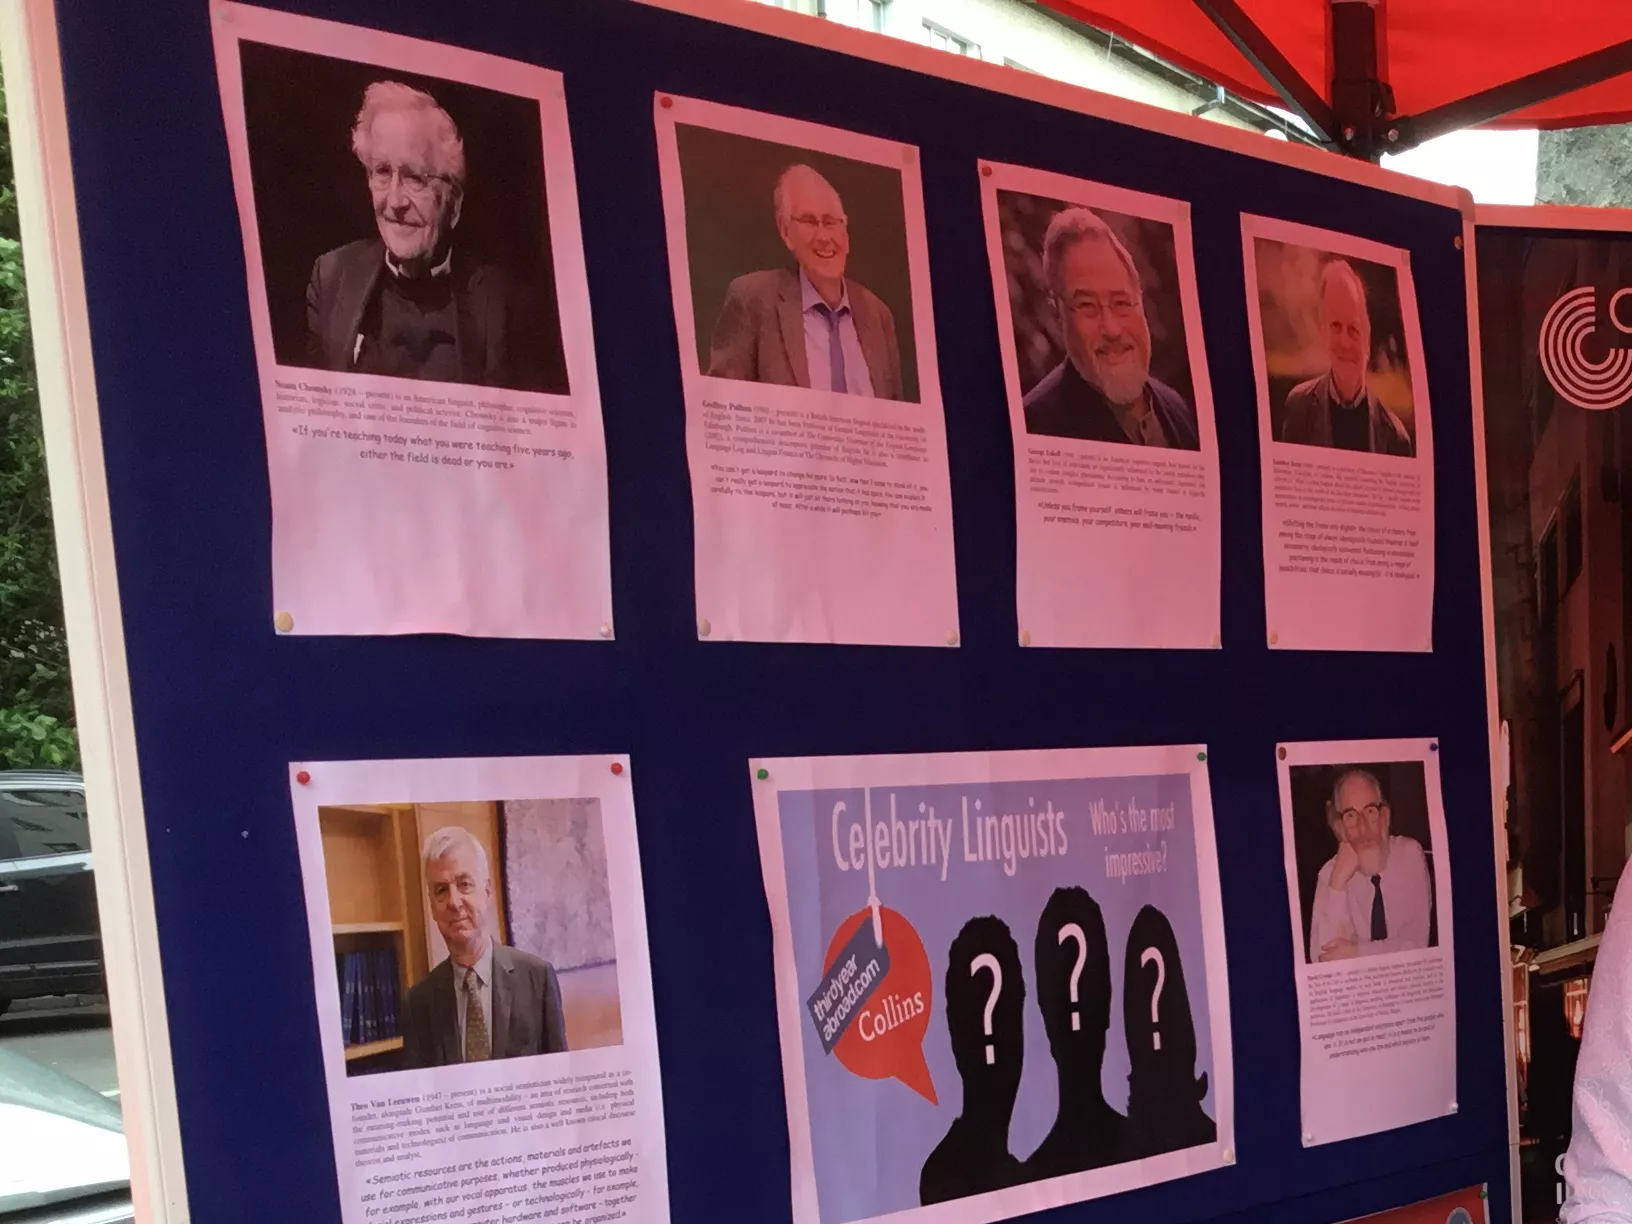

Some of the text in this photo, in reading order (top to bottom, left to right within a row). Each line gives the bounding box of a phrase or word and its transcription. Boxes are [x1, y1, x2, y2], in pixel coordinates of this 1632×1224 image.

[344, 430, 381, 445] teaching
[383, 433, 407, 446] today
[410, 435, 432, 446] what
[435, 439, 449, 449] you
[452, 441, 473, 450] were
[476, 440, 511, 456] teaching
[513, 444, 530, 455] five
[532, 446, 556, 458] years
[390, 451, 404, 462] the
[408, 451, 429, 463] field
[432, 455, 439, 463] is
[441, 455, 461, 466] dead
[477, 459, 493, 469] you
[832, 789, 1068, 881] Celebrity Linguists
[1089, 797, 1175, 835] Who's the most
[1104, 840, 1167, 885] impressive?
[813, 953, 858, 1022] thirdyear
[858, 991, 925, 1042] Collins
[413, 1165, 456, 1177] resources
[458, 1162, 472, 1171] are
[474, 1158, 488, 1168] the
[526, 1146, 566, 1160] materials
[567, 1143, 581, 1154] and
[582, 1138, 619, 1152] artefacts
[621, 1138, 632, 1146] we
[360, 1193, 376, 1202] use
[379, 1190, 394, 1199] for
[396, 1180, 458, 1196] communicative
[502, 1167, 539, 1180] whether
[541, 1159, 578, 1176] produced
[365, 1206, 380, 1215] for
[423, 1194, 443, 1206] with
[445, 1194, 460, 1203] our
[461, 1188, 482, 1200] vocal
[532, 1179, 547, 1189] the
[548, 1174, 580, 1186] muscles
[581, 1173, 592, 1181] we
[593, 1171, 606, 1179] use
[608, 1168, 616, 1177] to
[618, 1164, 638, 1175] make
[449, 1206, 464, 1218] and
[466, 1203, 503, 1218] gestures
[511, 1199, 522, 1207] or
[592, 1185, 605, 1194] for
[501, 1211, 541, 1224] hardware
[543, 1205, 558, 1217] and
[560, 1201, 597, 1214] software
[604, 1193, 637, 1208] together
